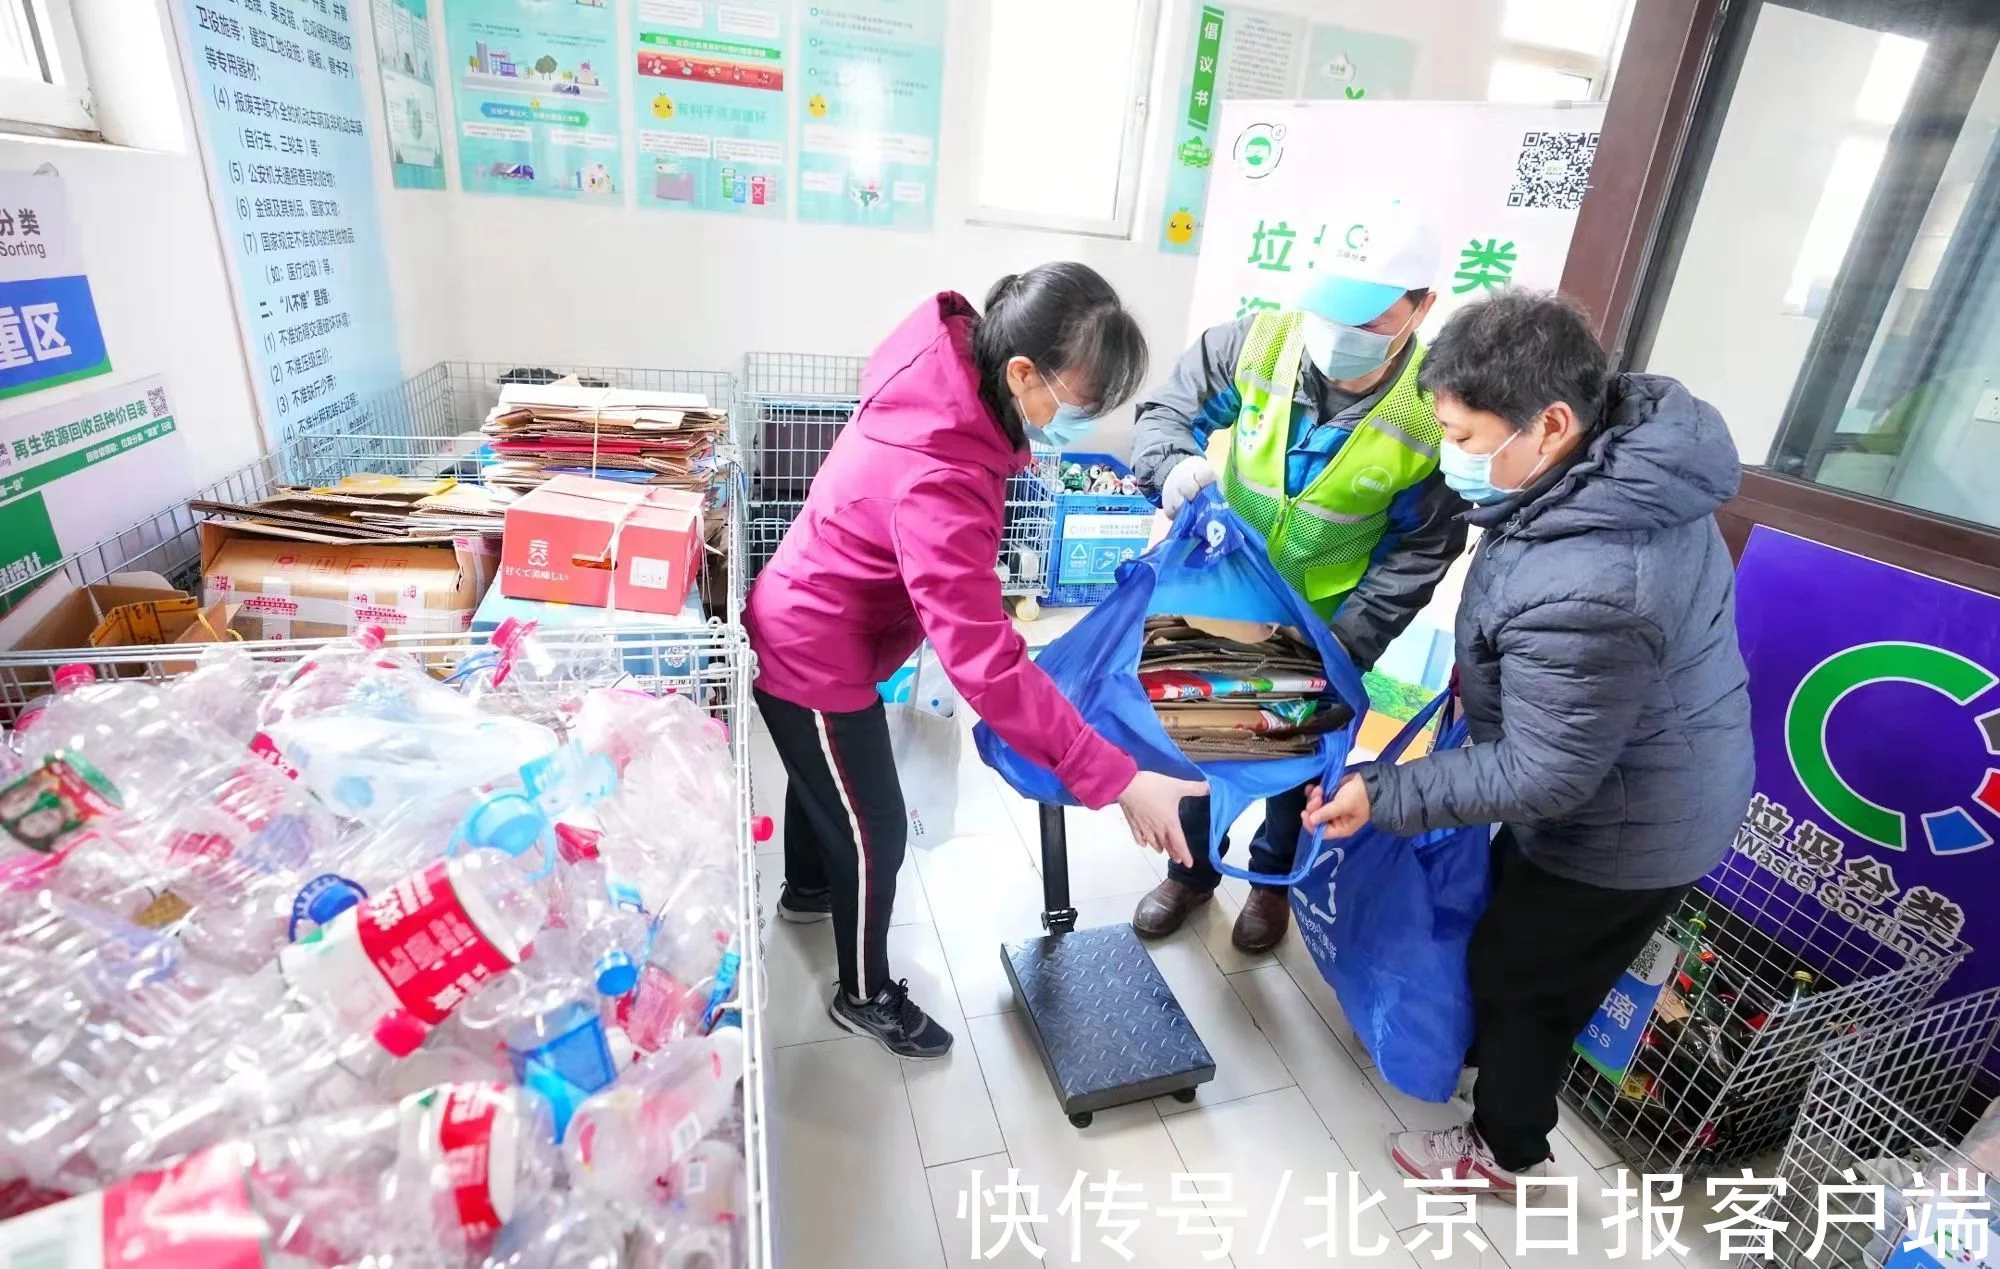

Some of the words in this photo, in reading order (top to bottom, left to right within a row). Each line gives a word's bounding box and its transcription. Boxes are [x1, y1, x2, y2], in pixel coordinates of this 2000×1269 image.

[1194, 22, 1218, 107] 倡议书
[12, 399, 148, 461] 再生资源回收品种价目表
[1735, 829, 1816, 895] Waste
[1748, 794, 1963, 946] 垃圾分类
